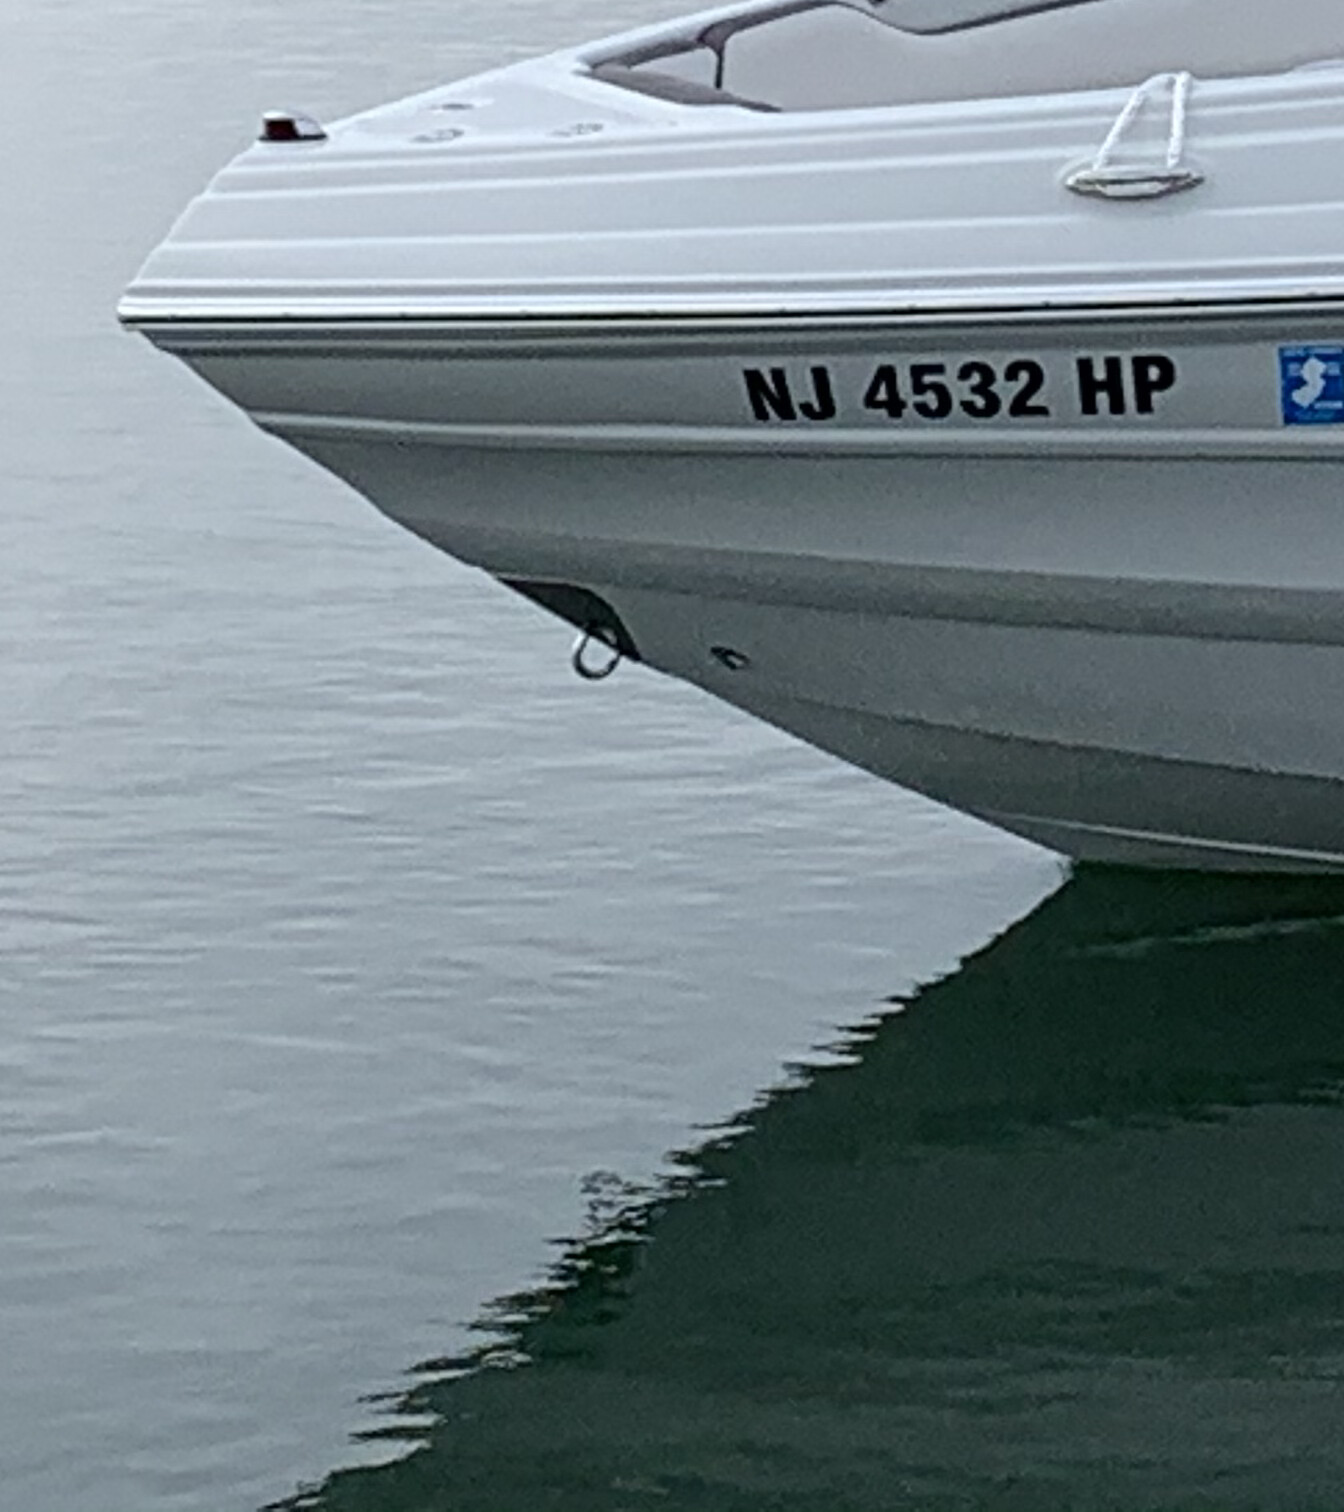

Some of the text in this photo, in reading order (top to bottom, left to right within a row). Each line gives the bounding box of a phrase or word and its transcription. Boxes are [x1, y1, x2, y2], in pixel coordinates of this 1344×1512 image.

[742, 354, 1176, 422] NJ 4532 HP
